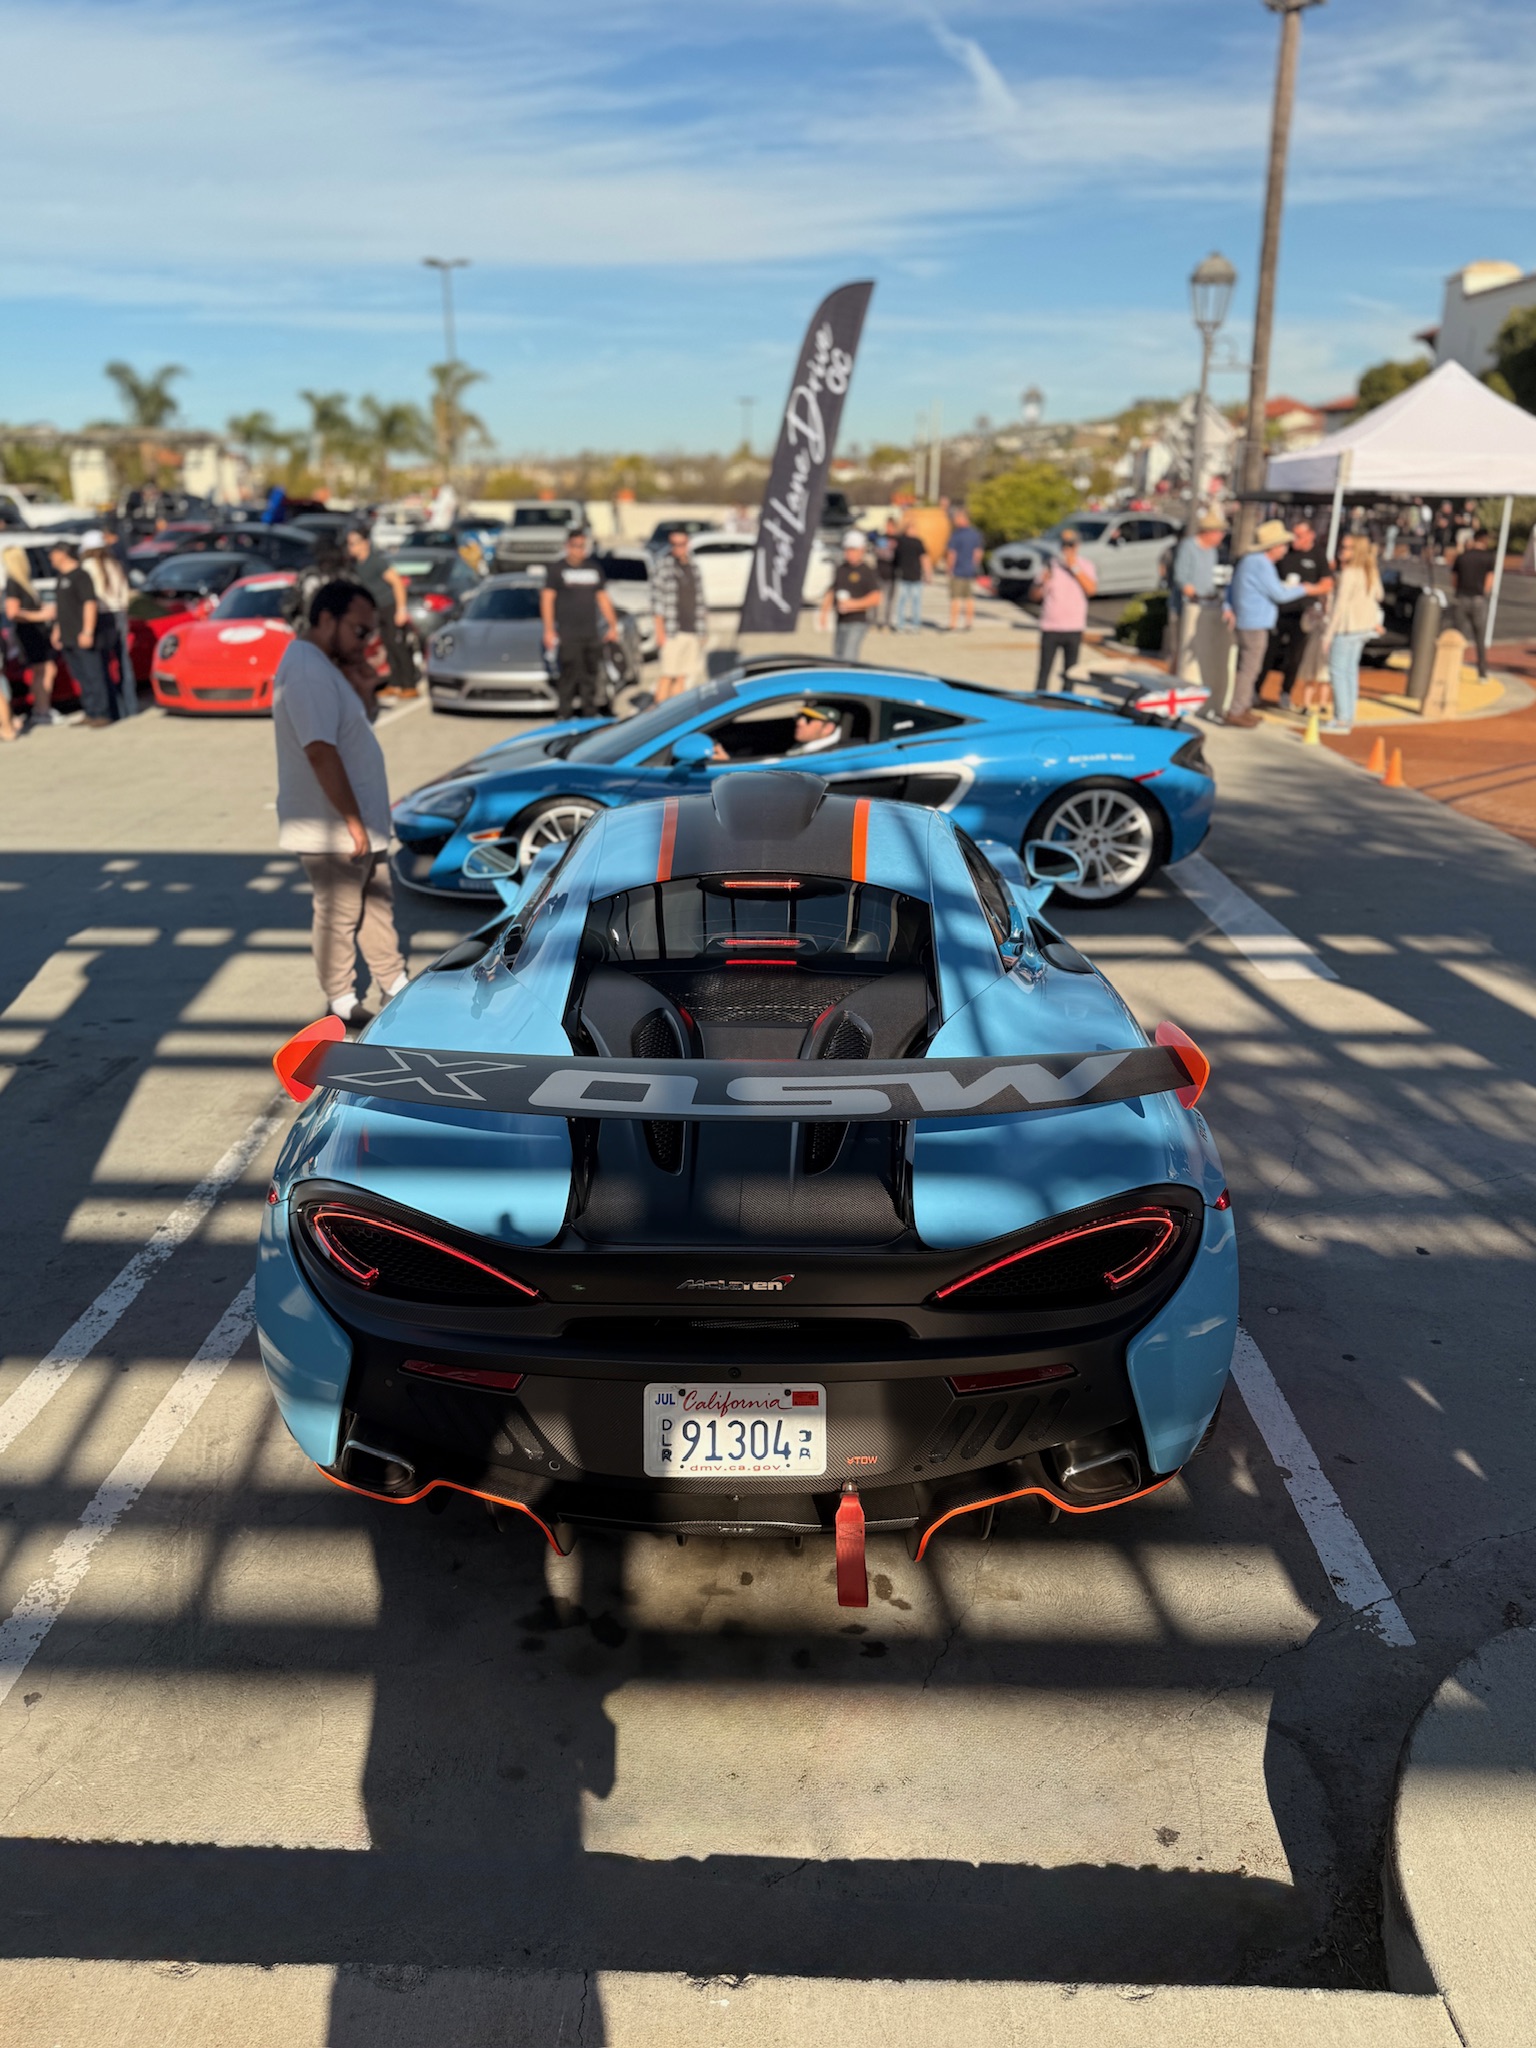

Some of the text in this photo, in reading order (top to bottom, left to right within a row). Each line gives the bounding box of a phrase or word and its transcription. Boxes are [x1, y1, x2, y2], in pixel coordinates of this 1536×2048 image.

[757, 322, 834, 614] Fast Lane Drive
[677, 1278, 783, 1291] McLaren
[655, 1393, 676, 1405] JUL
[682, 1390, 792, 1418] California
[681, 1419, 792, 1462] 91304
[853, 1455, 878, 1465] TOW
[690, 1463, 781, 1472] dmv.ca.gov
